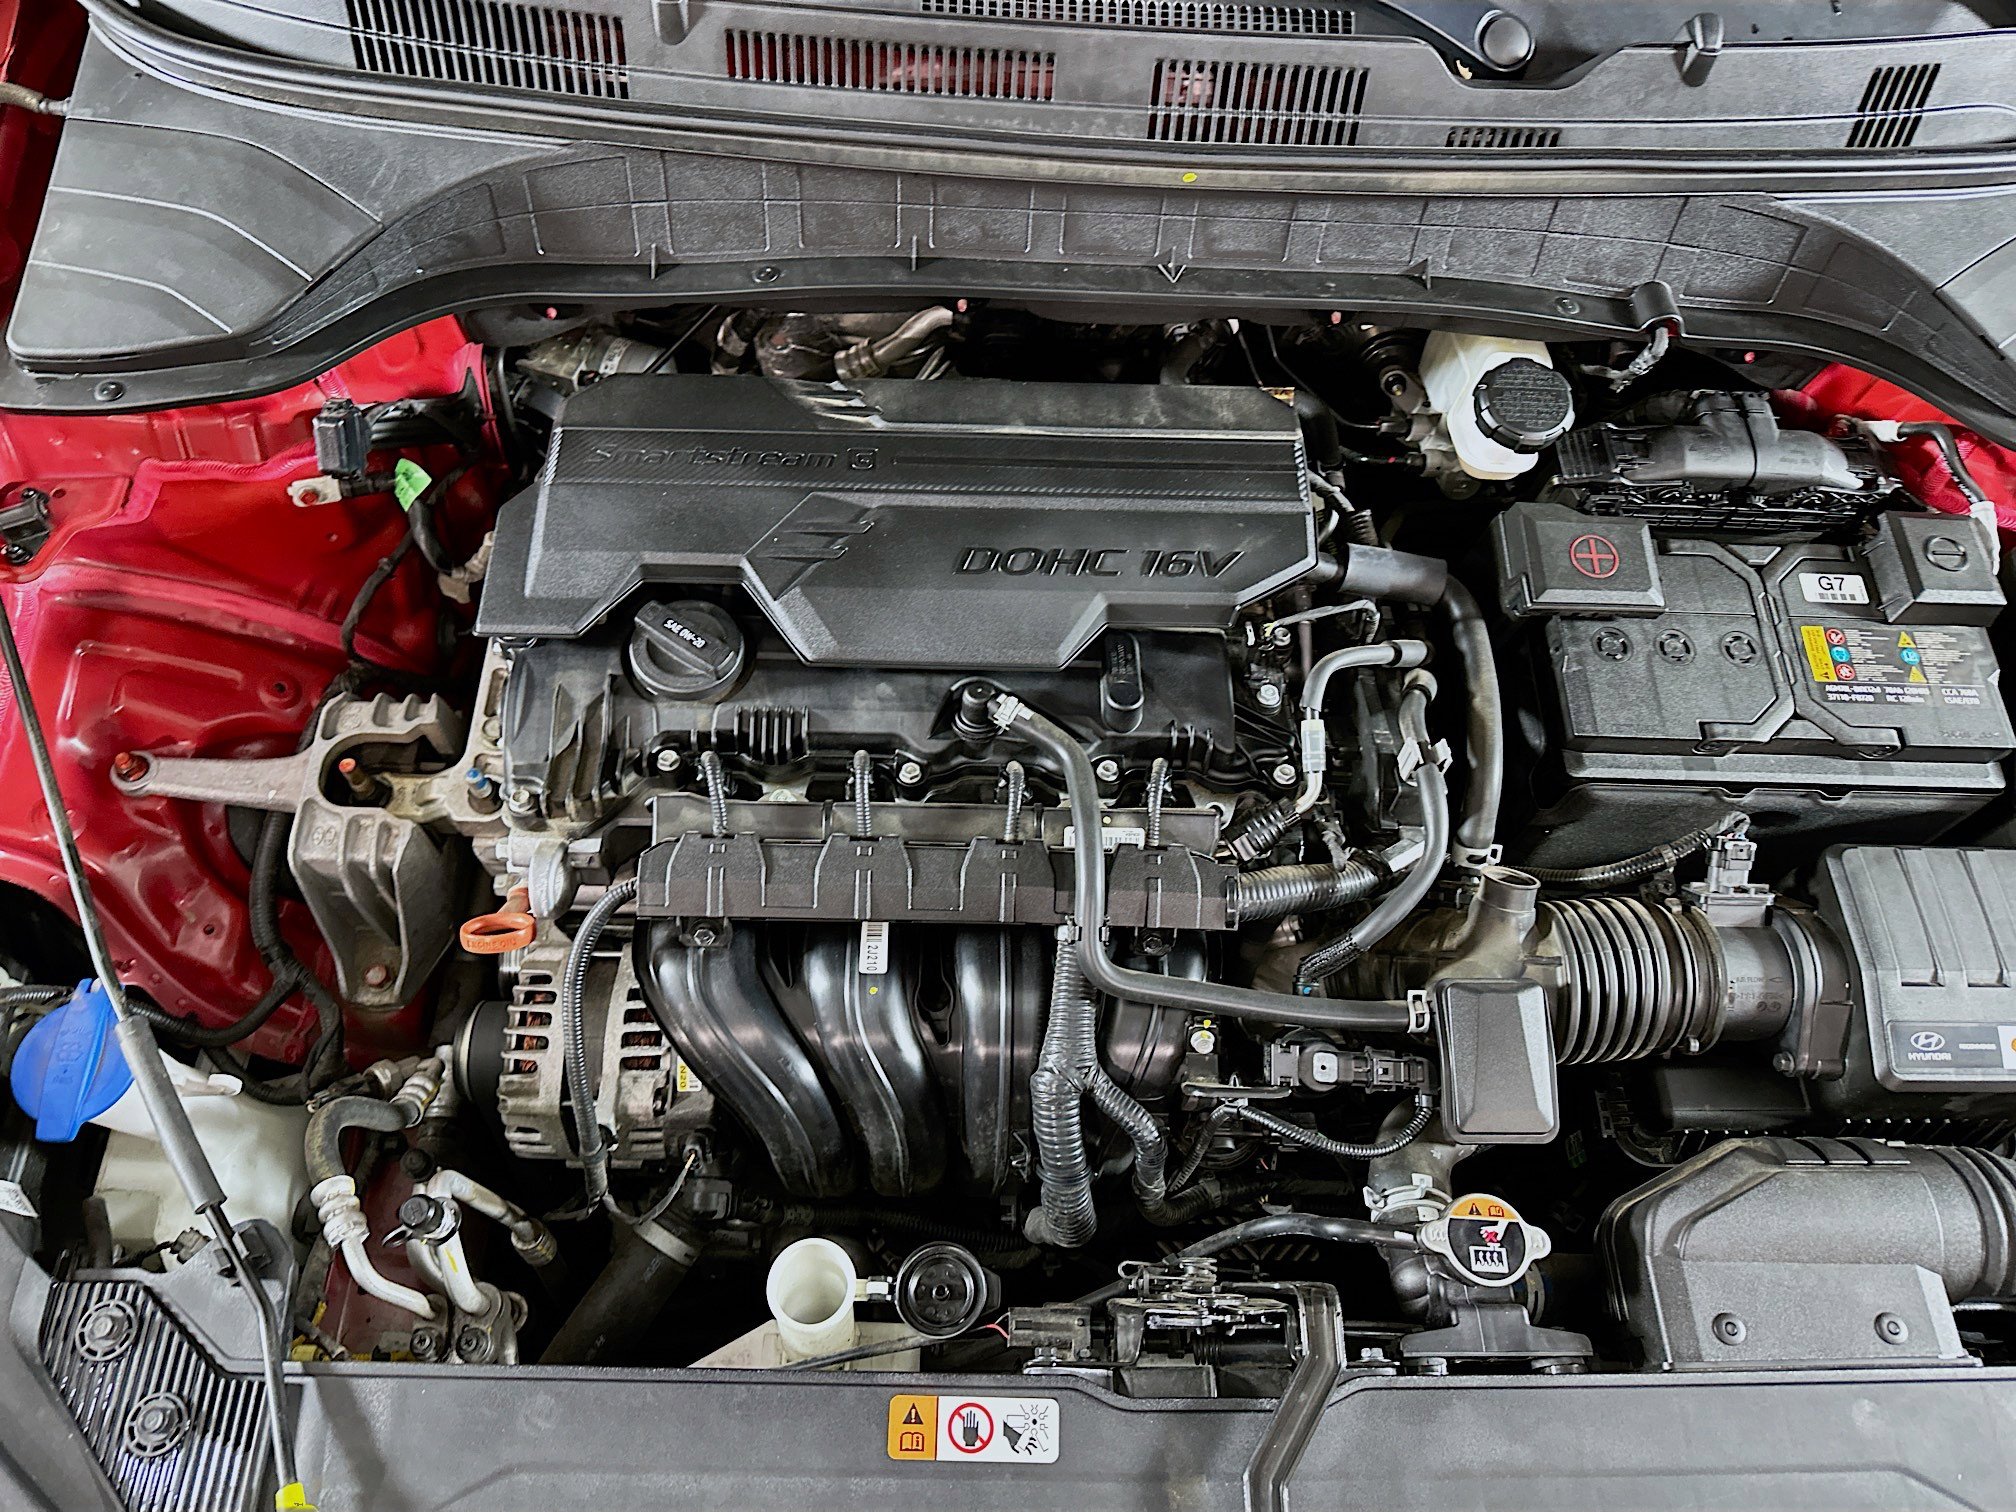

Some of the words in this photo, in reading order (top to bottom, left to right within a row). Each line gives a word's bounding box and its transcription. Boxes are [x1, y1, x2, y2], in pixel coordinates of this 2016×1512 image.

[584, 445, 838, 466] Smartstream
[952, 546, 1130, 577] DOHC
[1139, 548, 1245, 578] 16V
[1818, 576, 1845, 592] G7
[663, 619, 683, 634] SAE
[679, 629, 706, 649] 0W-20
[866, 944, 879, 972] 2J210
[1907, 1052, 1952, 1061] HYUNDAI
